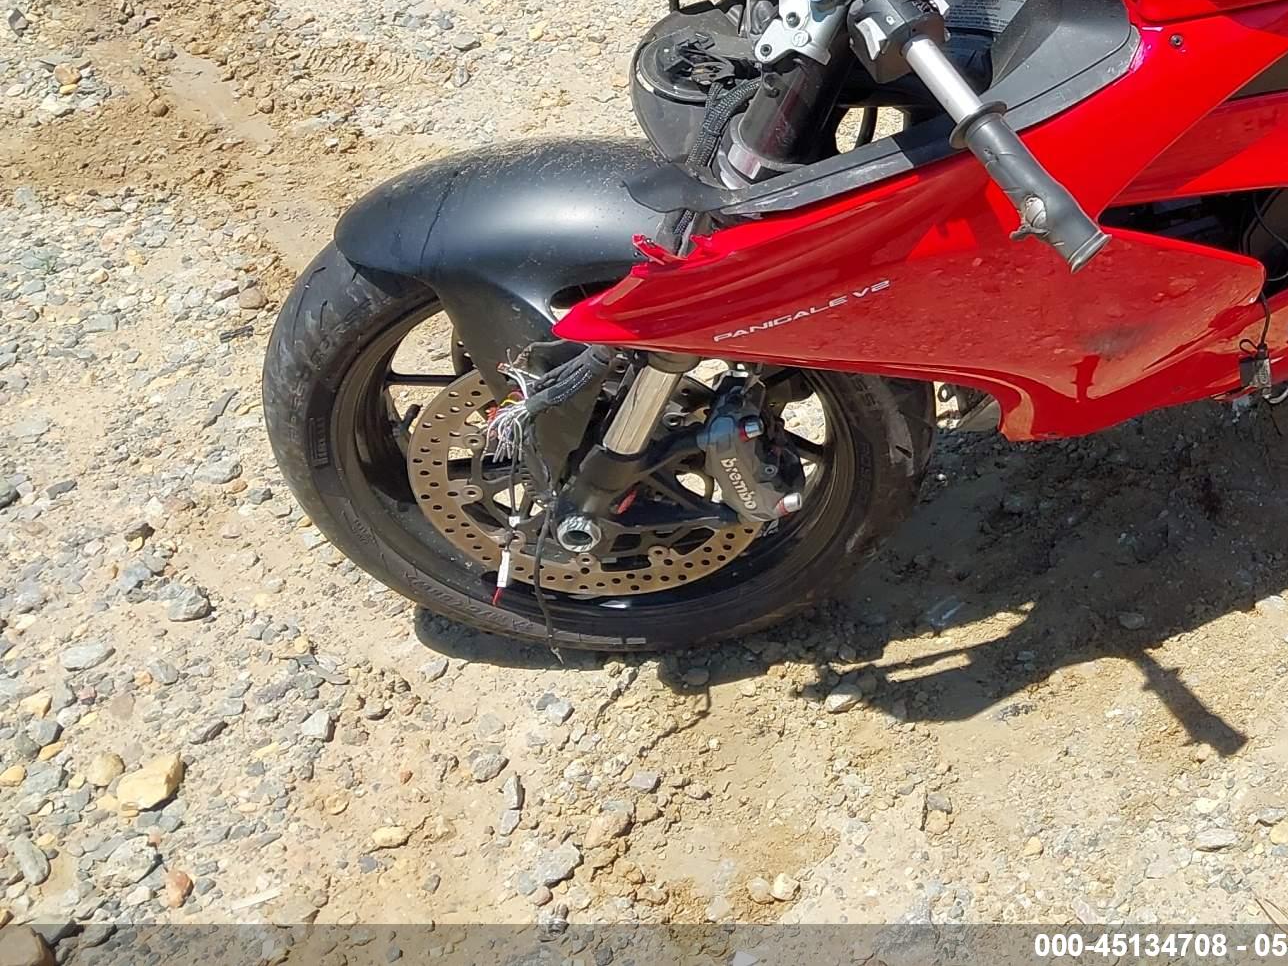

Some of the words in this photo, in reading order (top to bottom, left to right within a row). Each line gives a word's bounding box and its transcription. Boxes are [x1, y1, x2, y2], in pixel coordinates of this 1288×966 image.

[713, 295, 849, 343] PANIGALE
[852, 279, 890, 298] V2
[720, 457, 758, 511] brembo
